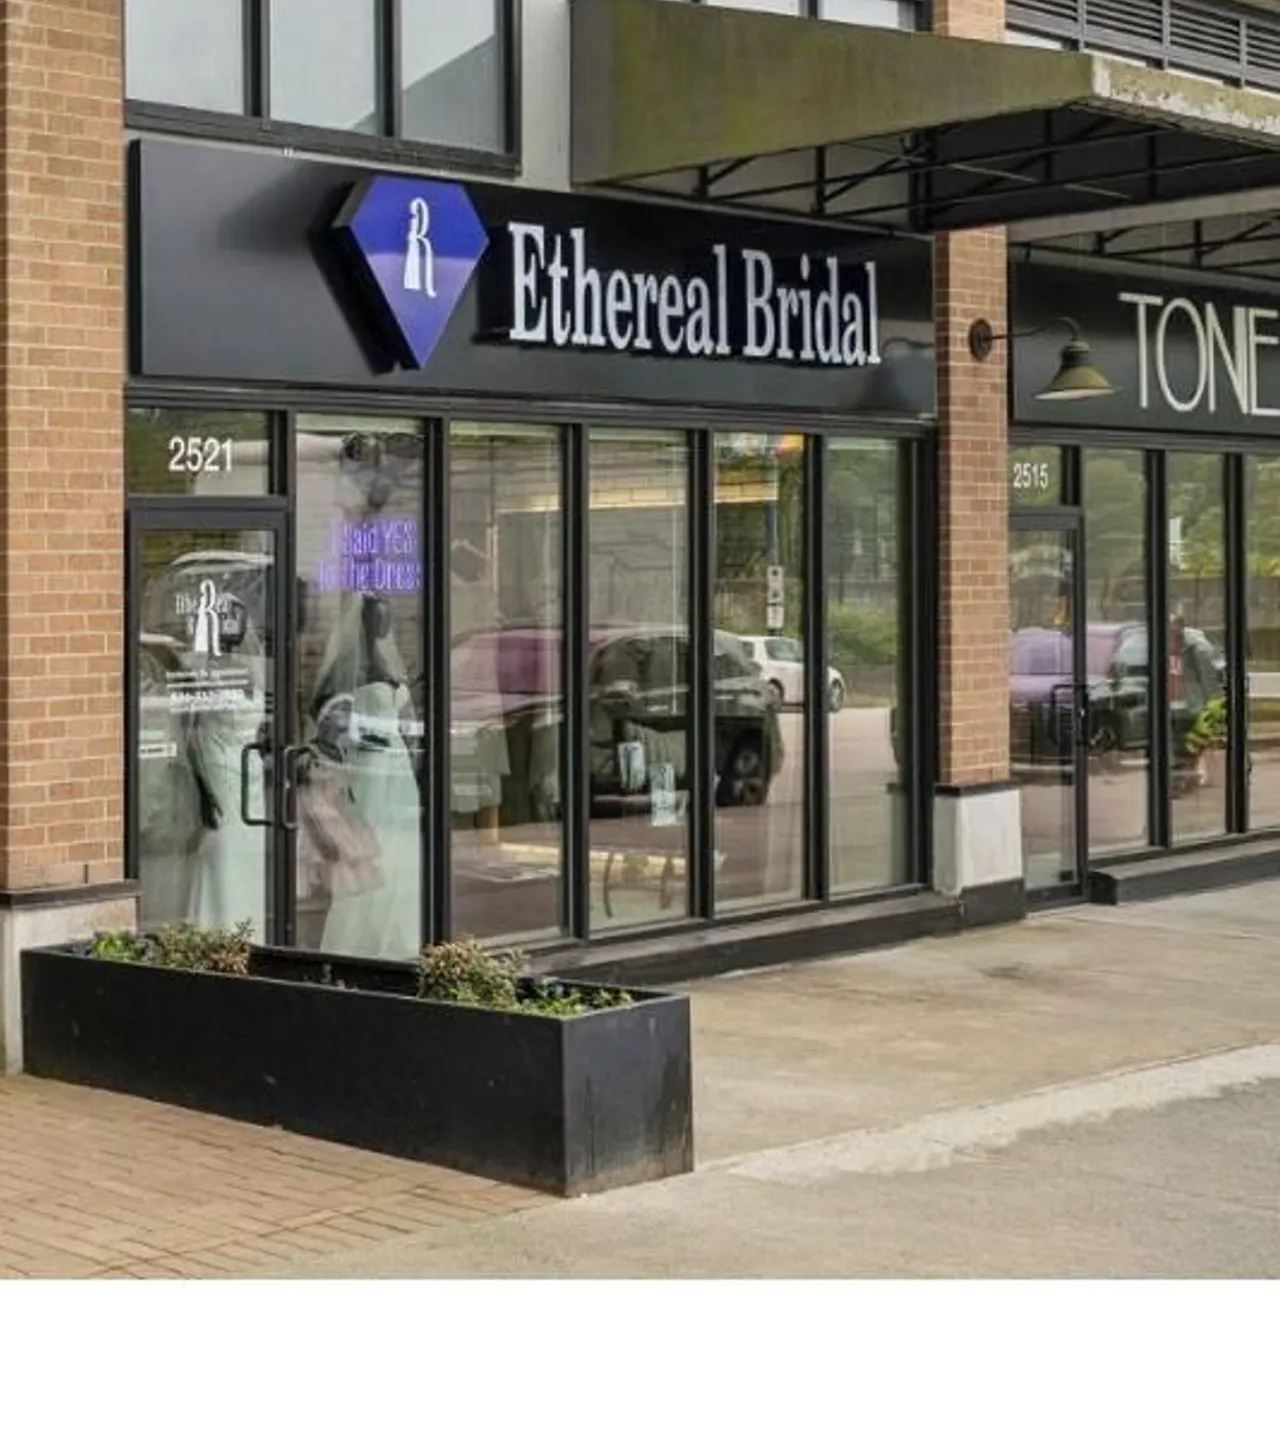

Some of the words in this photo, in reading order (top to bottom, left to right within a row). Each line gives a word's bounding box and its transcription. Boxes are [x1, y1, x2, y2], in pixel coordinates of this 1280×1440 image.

[508, 221, 731, 357] Ethereal
[742, 249, 882, 366] Bridal
[1118, 291, 1280, 417] TONE
[168, 436, 234, 472] 2521
[1012, 463, 1050, 489] 2515
